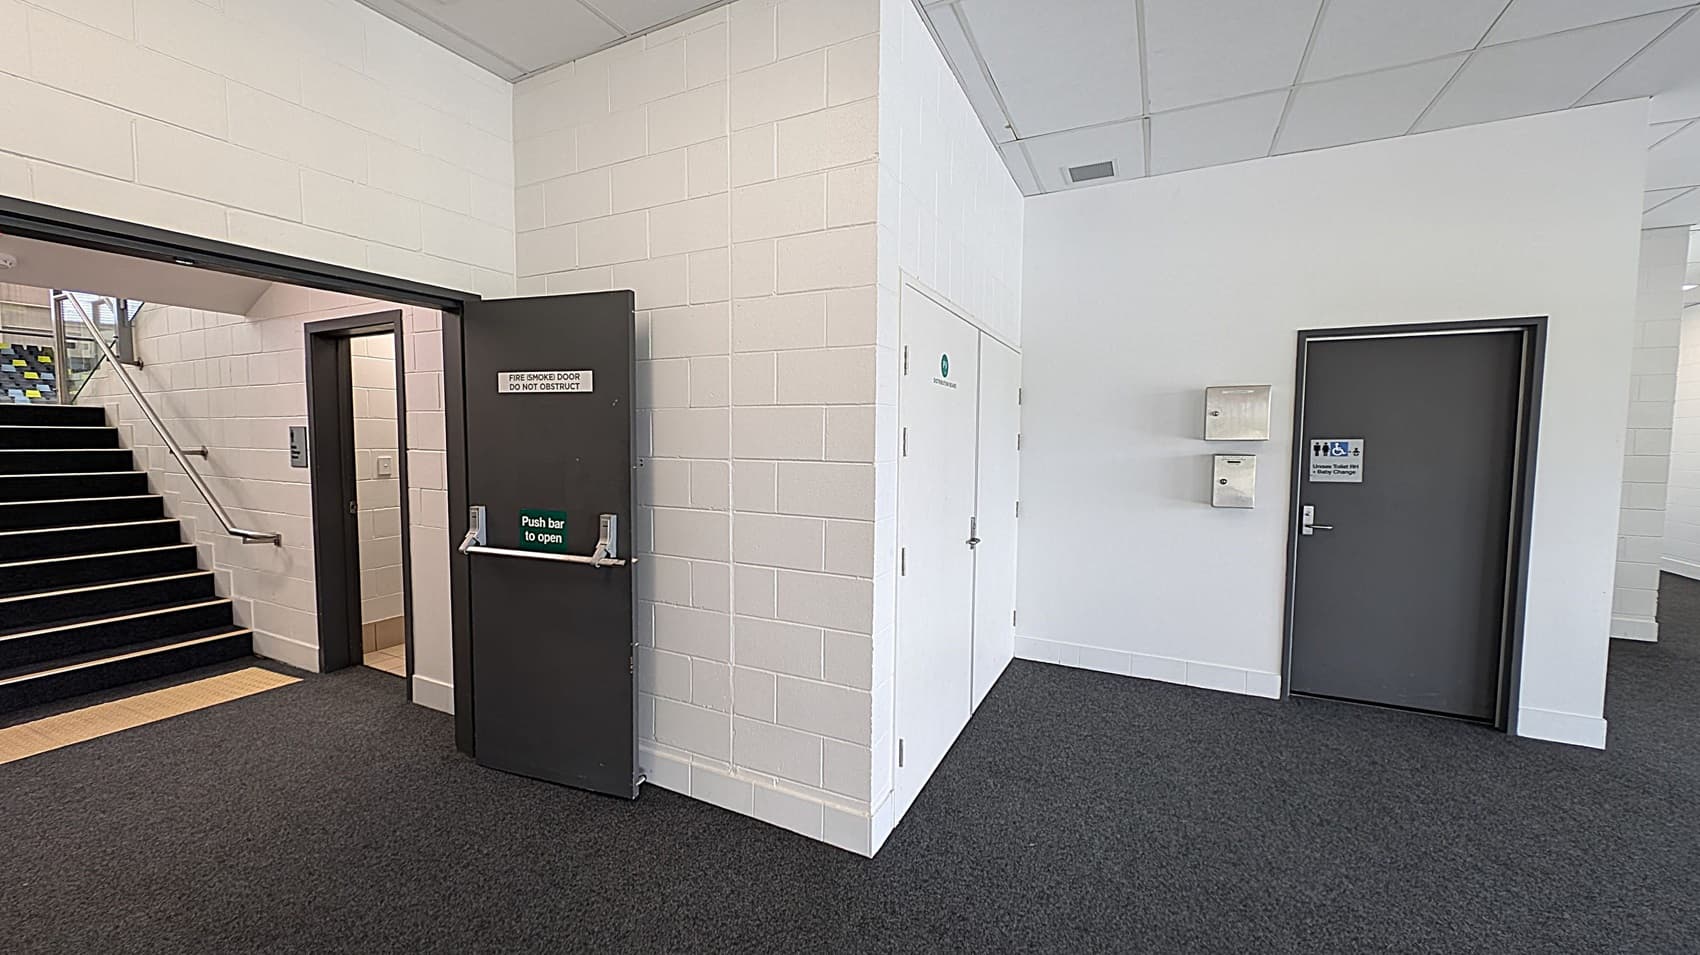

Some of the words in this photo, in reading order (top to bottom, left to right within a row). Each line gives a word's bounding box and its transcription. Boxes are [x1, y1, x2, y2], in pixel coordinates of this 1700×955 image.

[540, 382, 580, 390] OBSTRUCT
[522, 516, 546, 528] Push
[548, 517, 565, 529] bar
[525, 530, 536, 541] to
[538, 533, 562, 544] open
